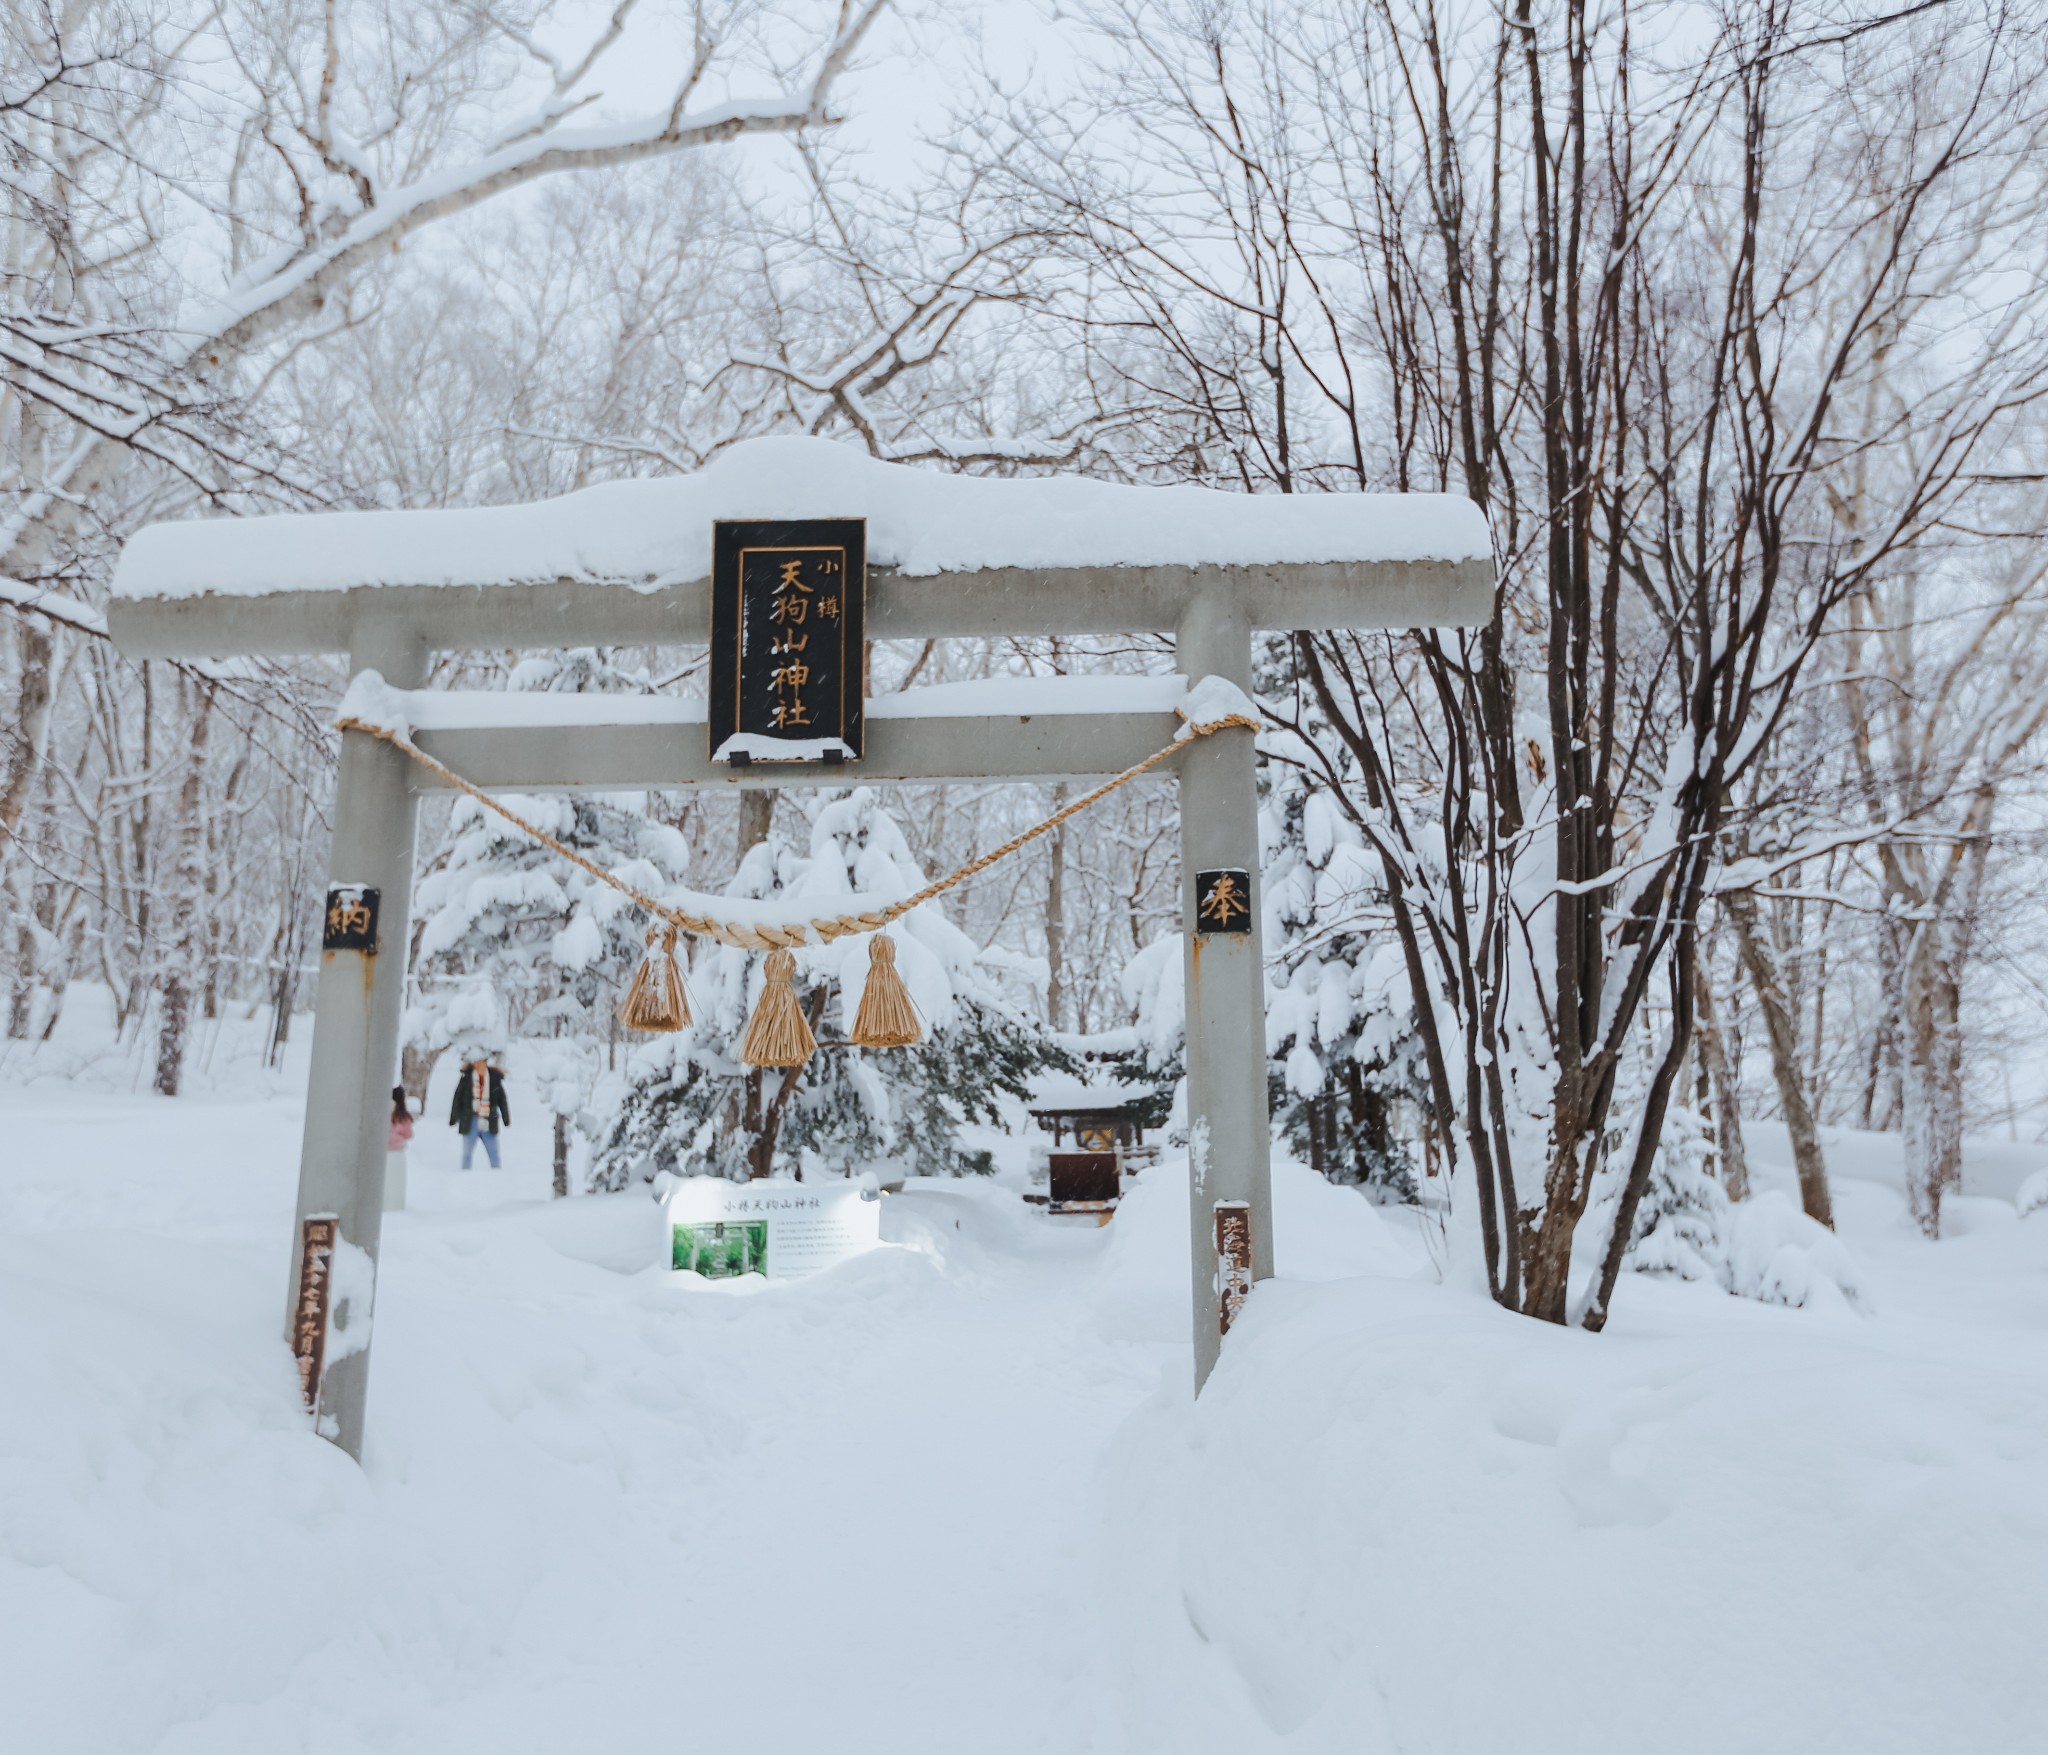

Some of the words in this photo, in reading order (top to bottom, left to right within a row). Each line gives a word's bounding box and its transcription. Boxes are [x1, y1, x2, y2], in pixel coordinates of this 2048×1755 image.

[817, 559, 840, 620] 小樽
[767, 559, 814, 731] 天狗山神社
[325, 890, 372, 940] 納
[1199, 871, 1249, 928] 奉
